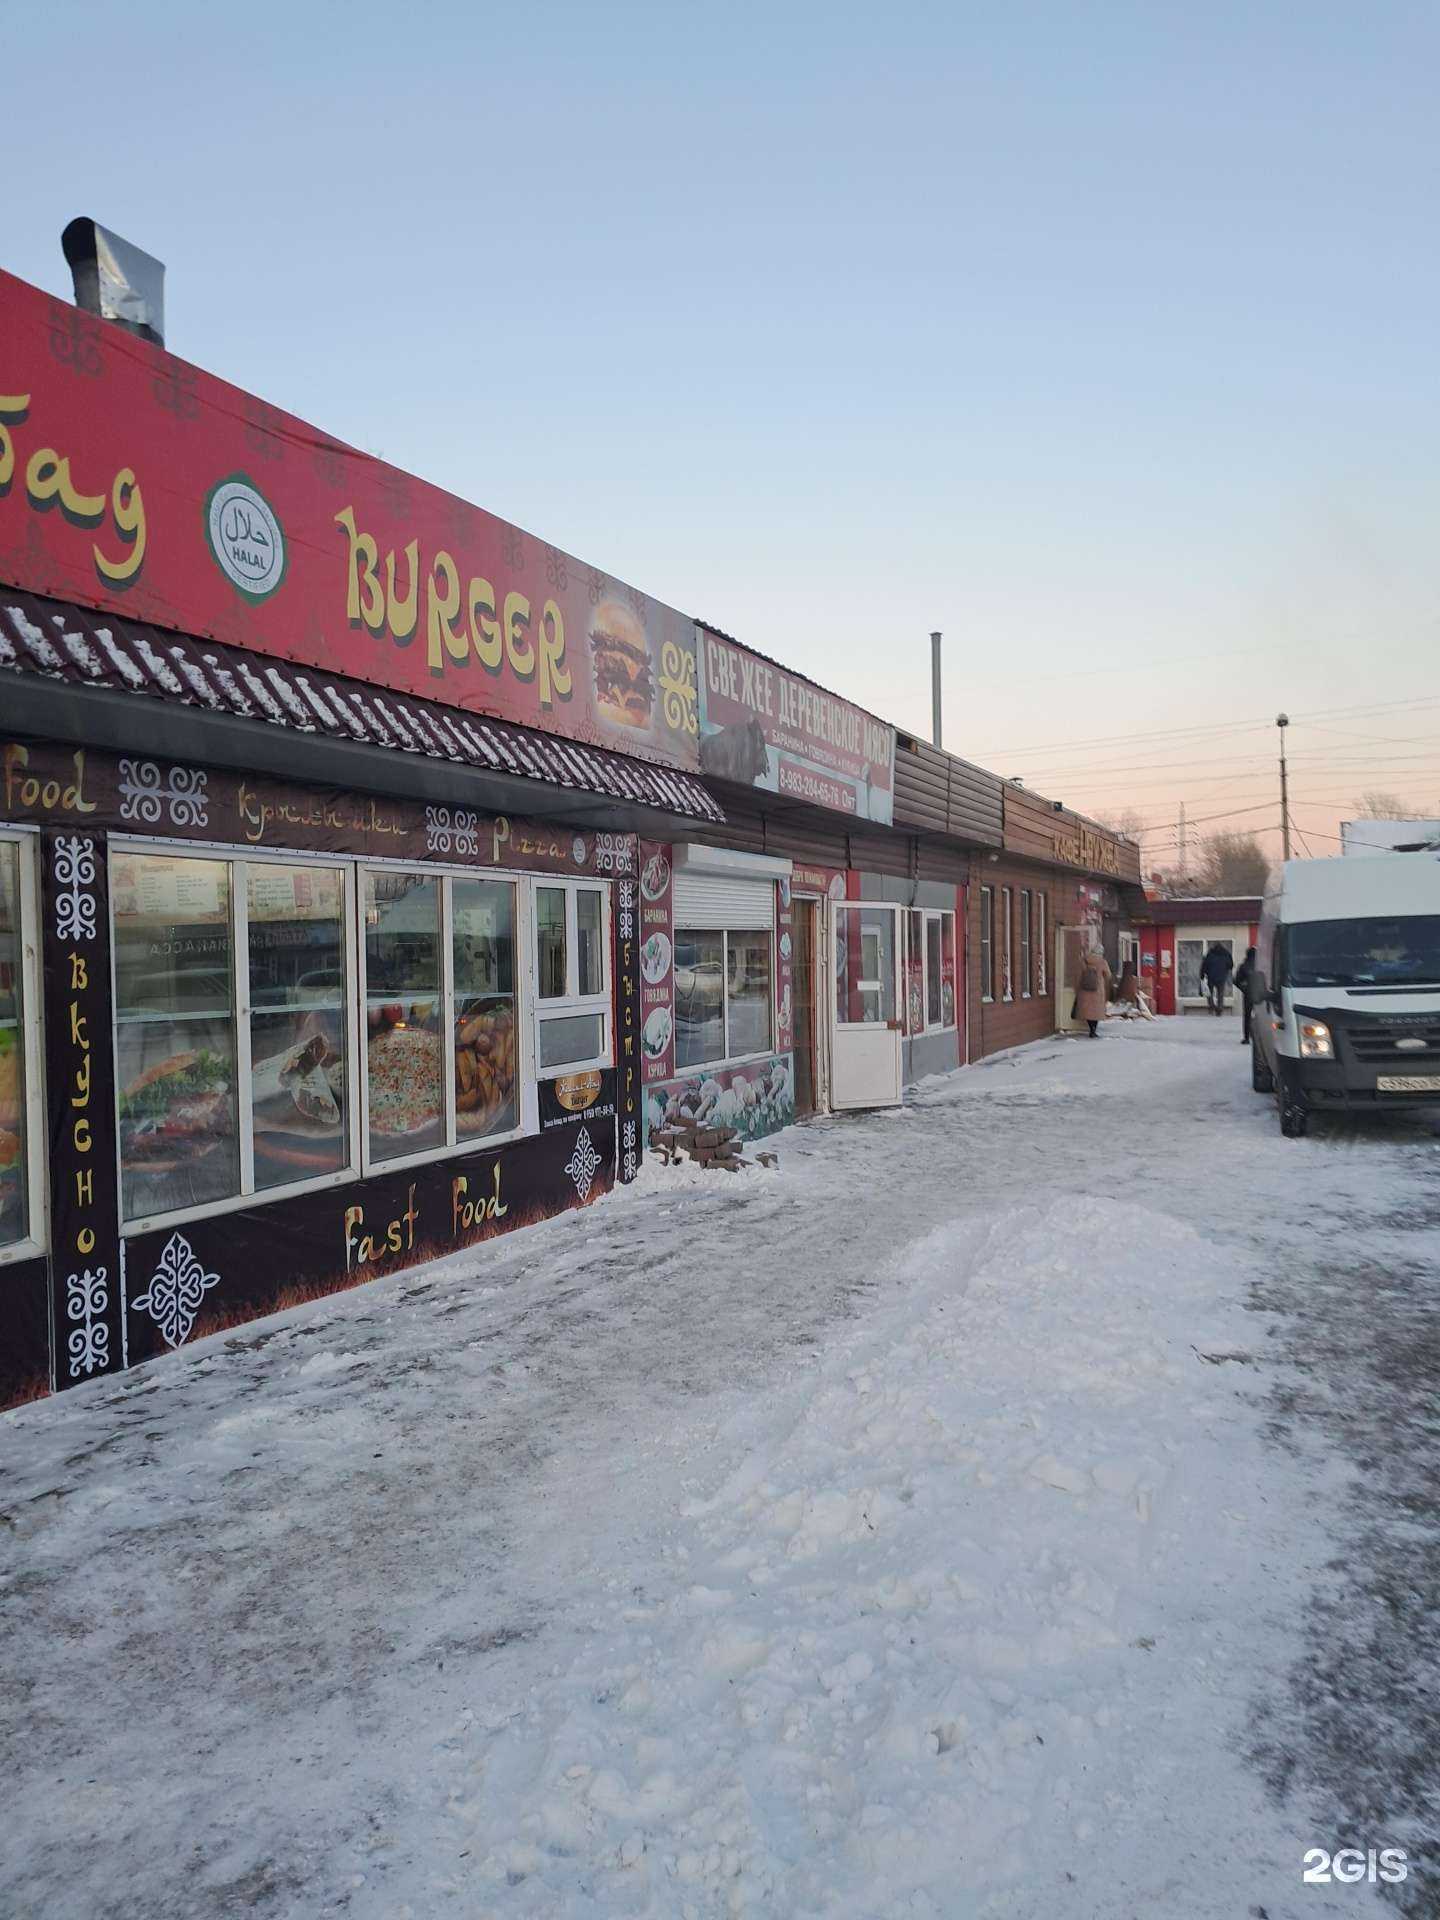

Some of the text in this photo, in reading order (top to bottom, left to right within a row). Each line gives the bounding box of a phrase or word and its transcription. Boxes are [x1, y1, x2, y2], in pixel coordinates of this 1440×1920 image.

[225, 506, 269, 547] حلال
[232, 547, 266, 570] HALAL
[334, 505, 572, 703] BURGER
[778, 676, 861, 755] ДЕРЕВЕНСКОЕ
[862, 715, 891, 768] МЯСО
[5, 743, 98, 813] Food
[344, 1160, 508, 1274] Fast Food
